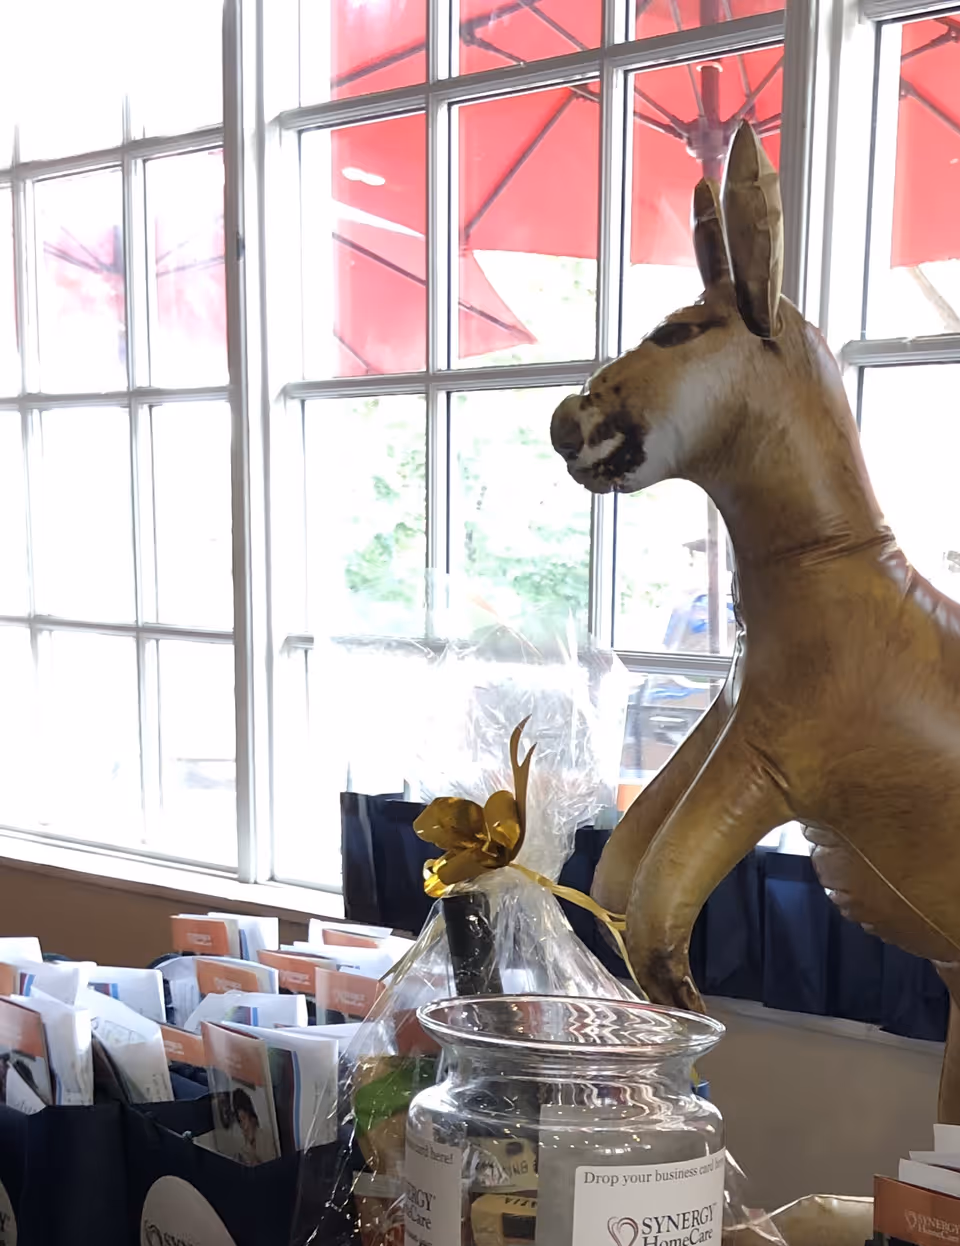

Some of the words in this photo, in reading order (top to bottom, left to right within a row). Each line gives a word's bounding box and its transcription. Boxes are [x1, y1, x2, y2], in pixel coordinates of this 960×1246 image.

[583, 1171, 619, 1187] Drop
[621, 1172, 652, 1186] your
[655, 1167, 698, 1183] business
[641, 1204, 713, 1235] SYNERGY
[917, 1215, 960, 1235] SYNERGY
